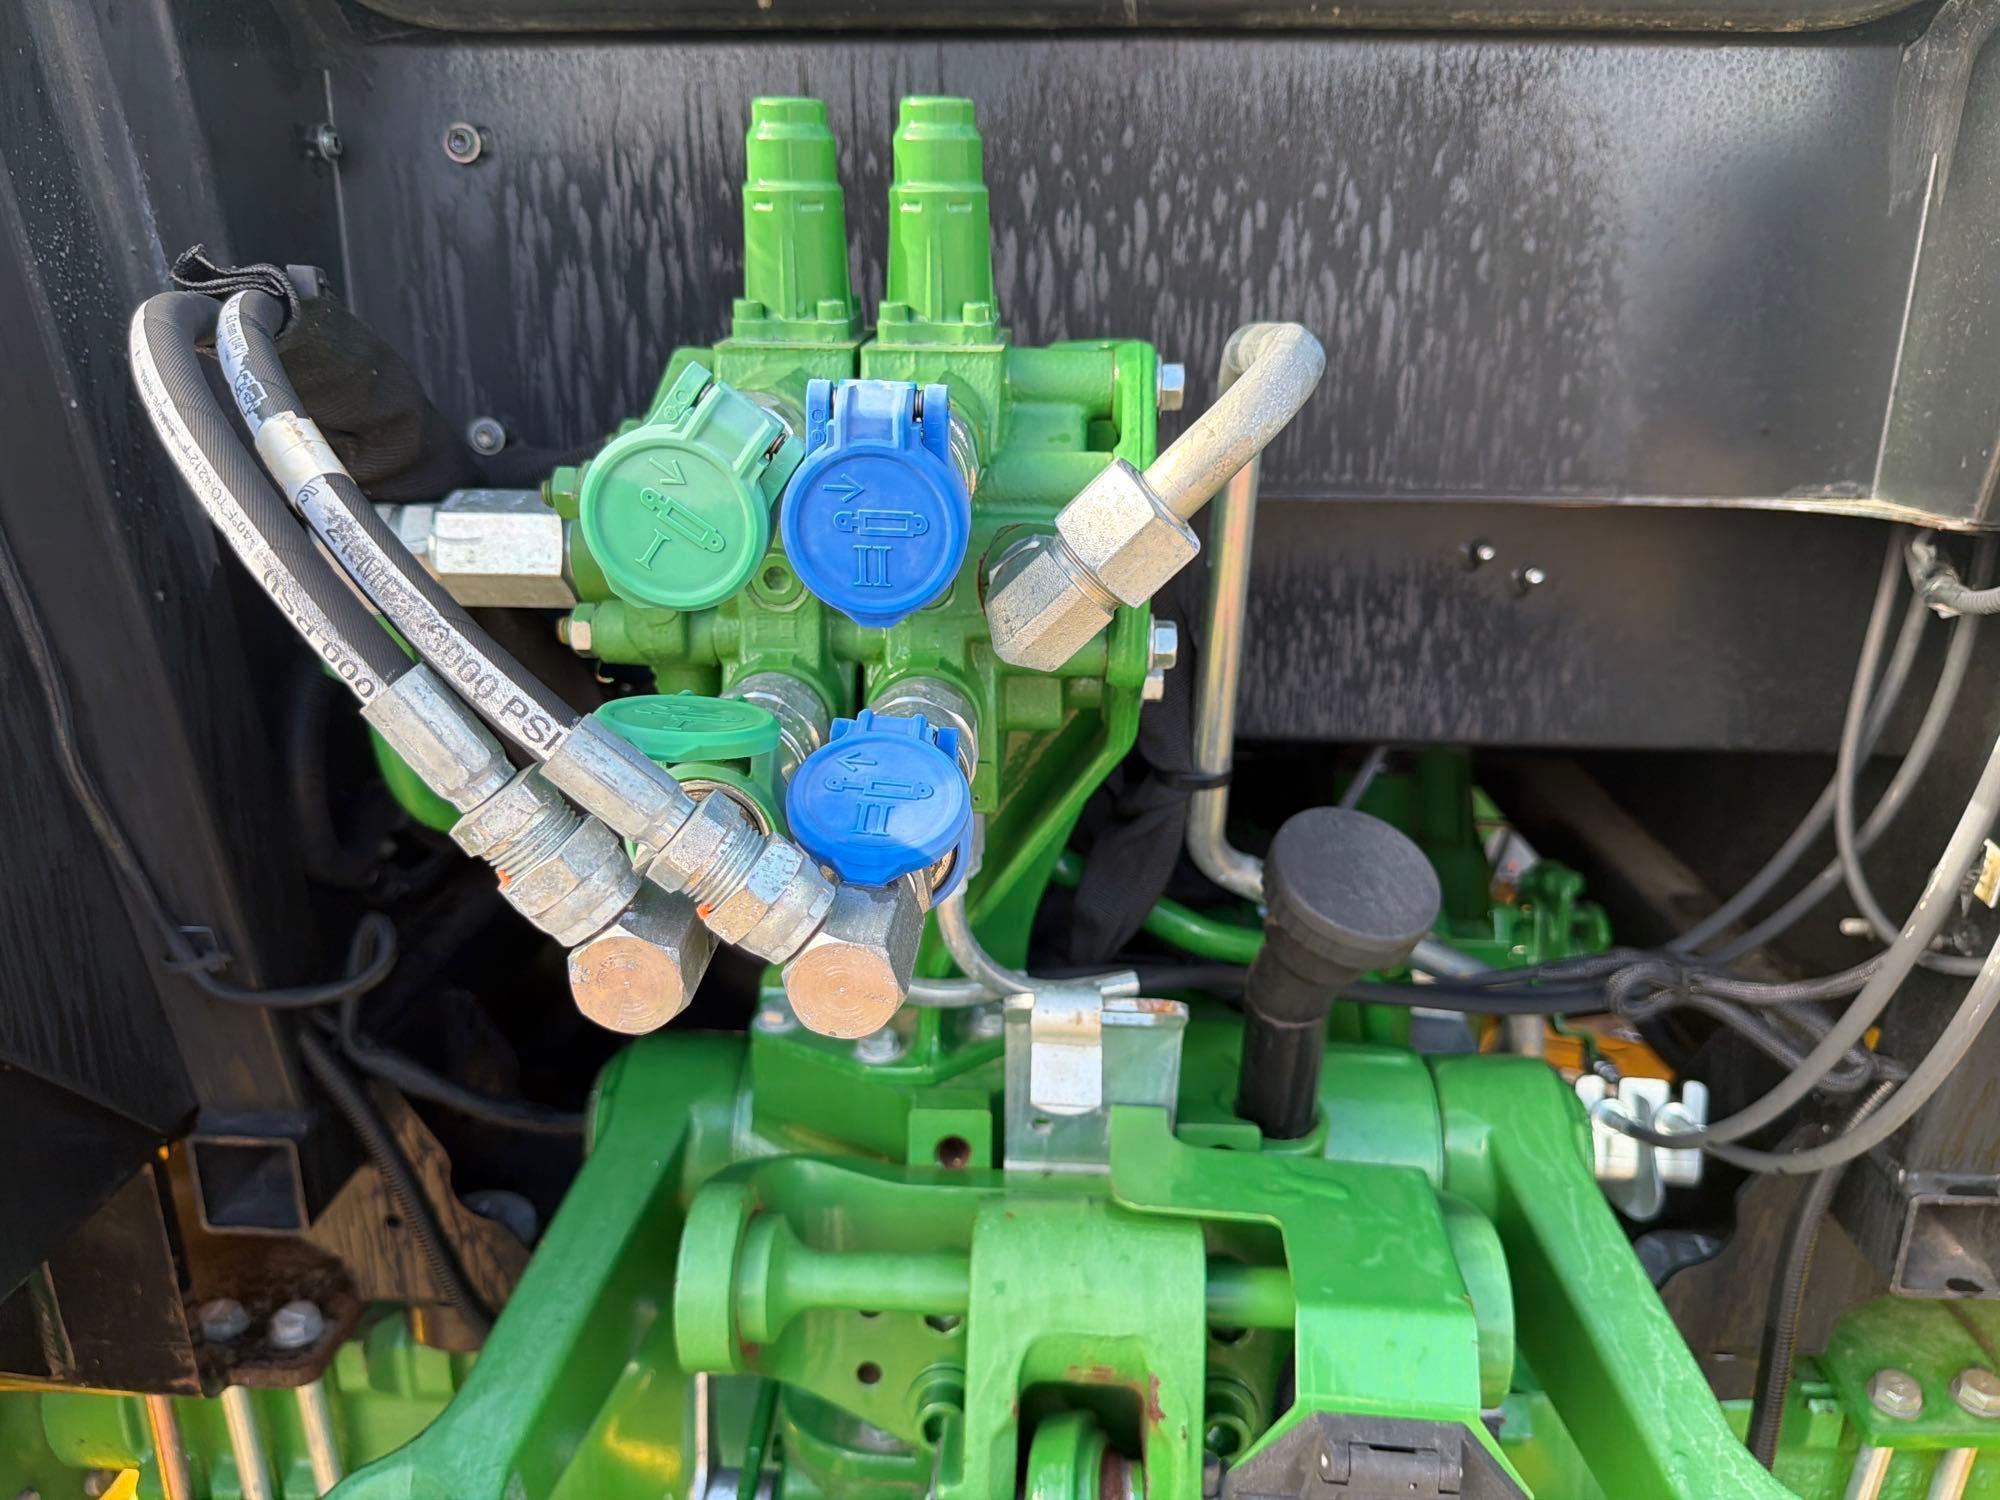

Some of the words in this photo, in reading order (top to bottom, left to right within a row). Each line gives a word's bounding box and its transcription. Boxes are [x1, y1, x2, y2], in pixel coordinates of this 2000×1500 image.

[852, 545, 894, 588] II
[500, 695, 563, 750] PSI
[850, 800, 896, 837] II
